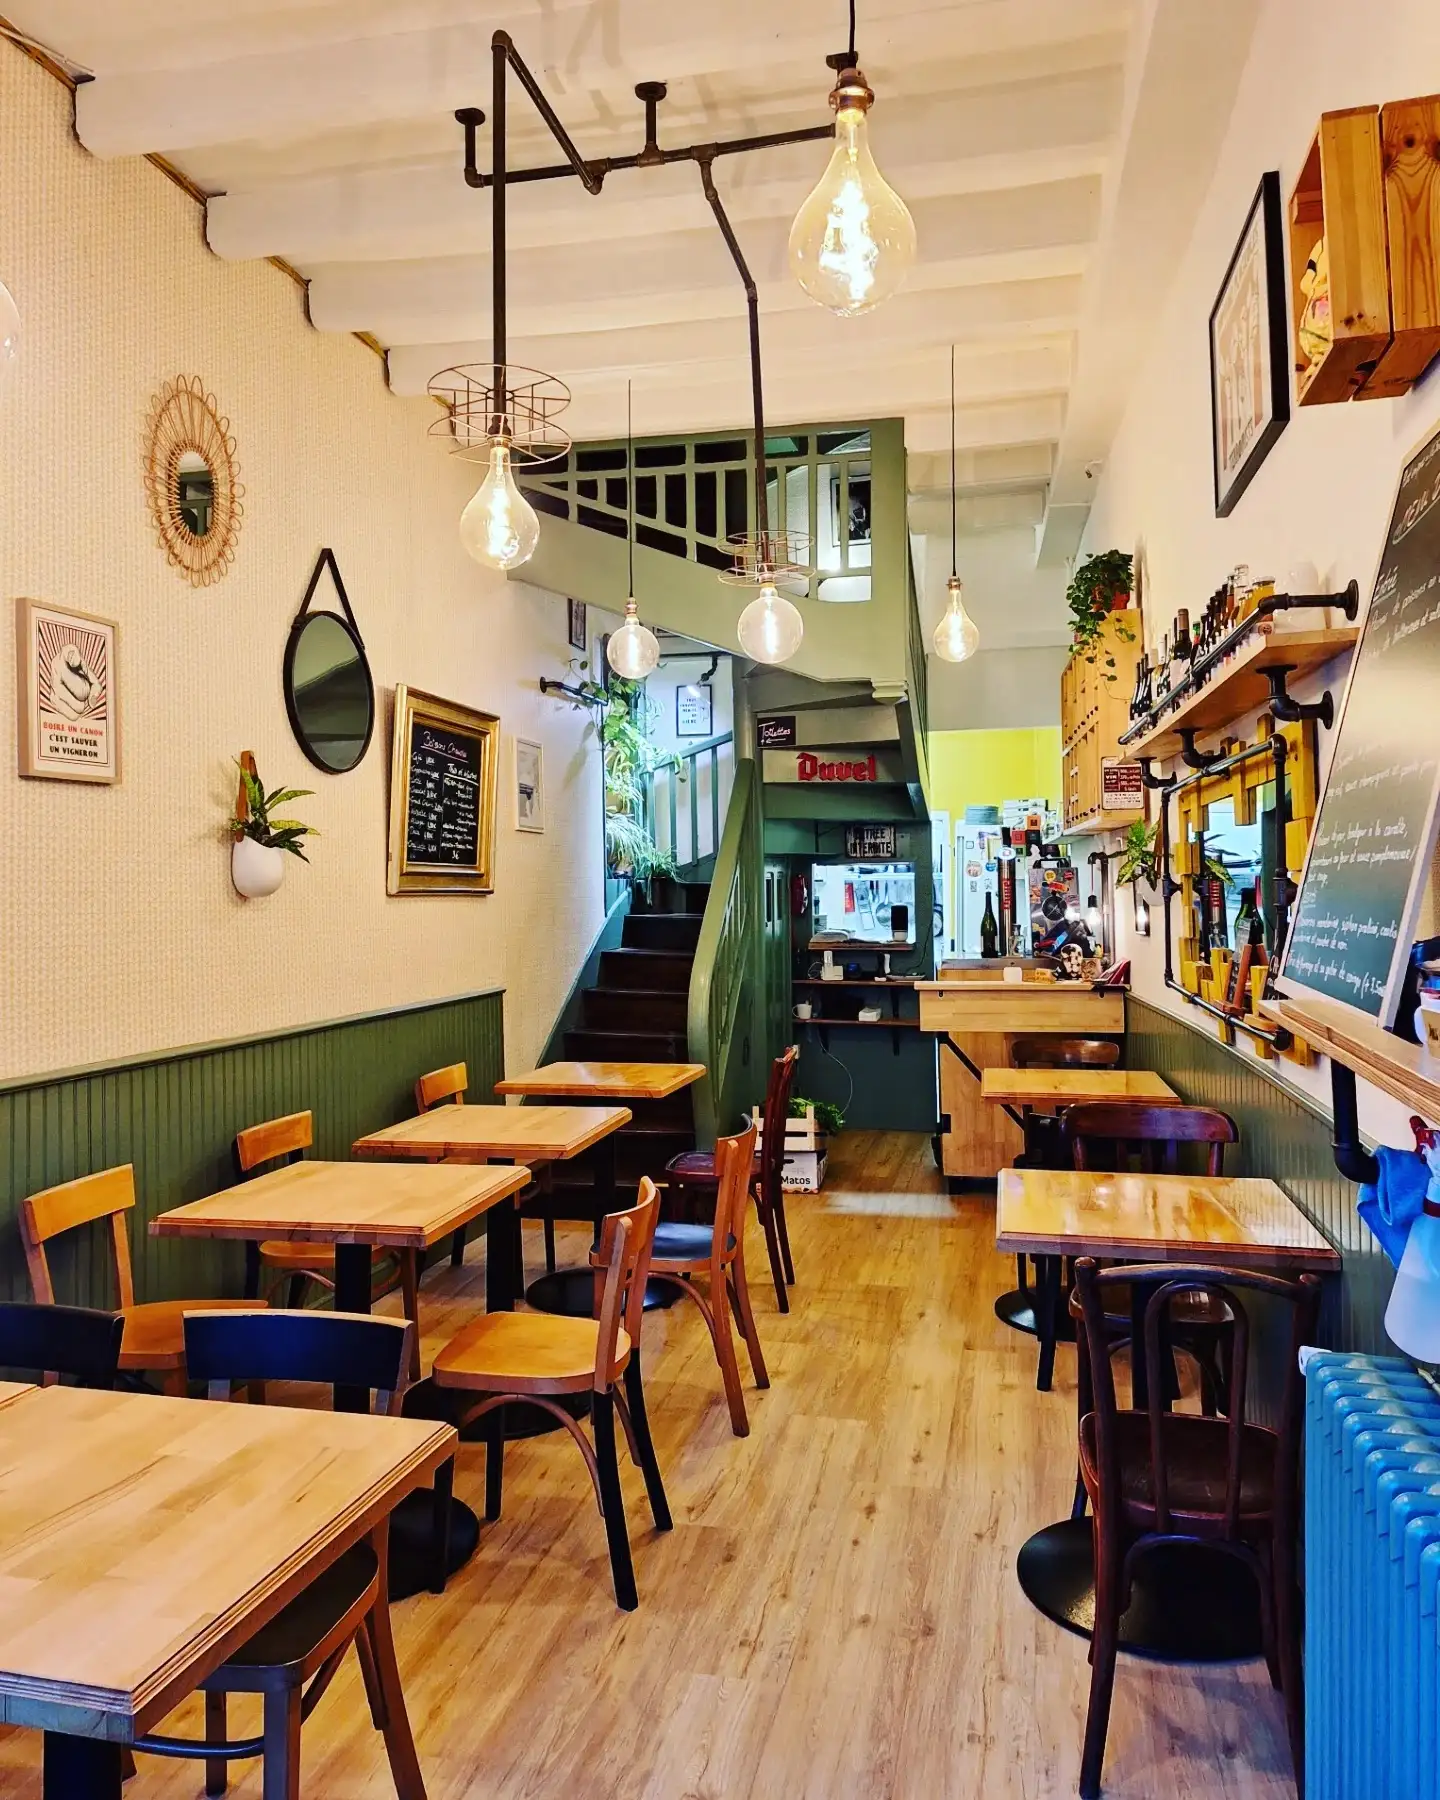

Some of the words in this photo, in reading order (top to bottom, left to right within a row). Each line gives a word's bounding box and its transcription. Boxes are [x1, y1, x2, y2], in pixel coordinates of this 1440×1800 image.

[43, 722, 64, 731] BOIRE
[68, 725, 77, 733] UN
[80, 727, 103, 736] CANON
[758, 721, 791, 739] Toilettes
[49, 733, 68, 743] C'EST
[72, 736, 98, 747] SAUVER
[49, 745, 60, 753] UN
[62, 747, 98, 758] VIGNERON
[796, 752, 878, 781] Duvel
[782, 1176, 811, 1185] Matos
